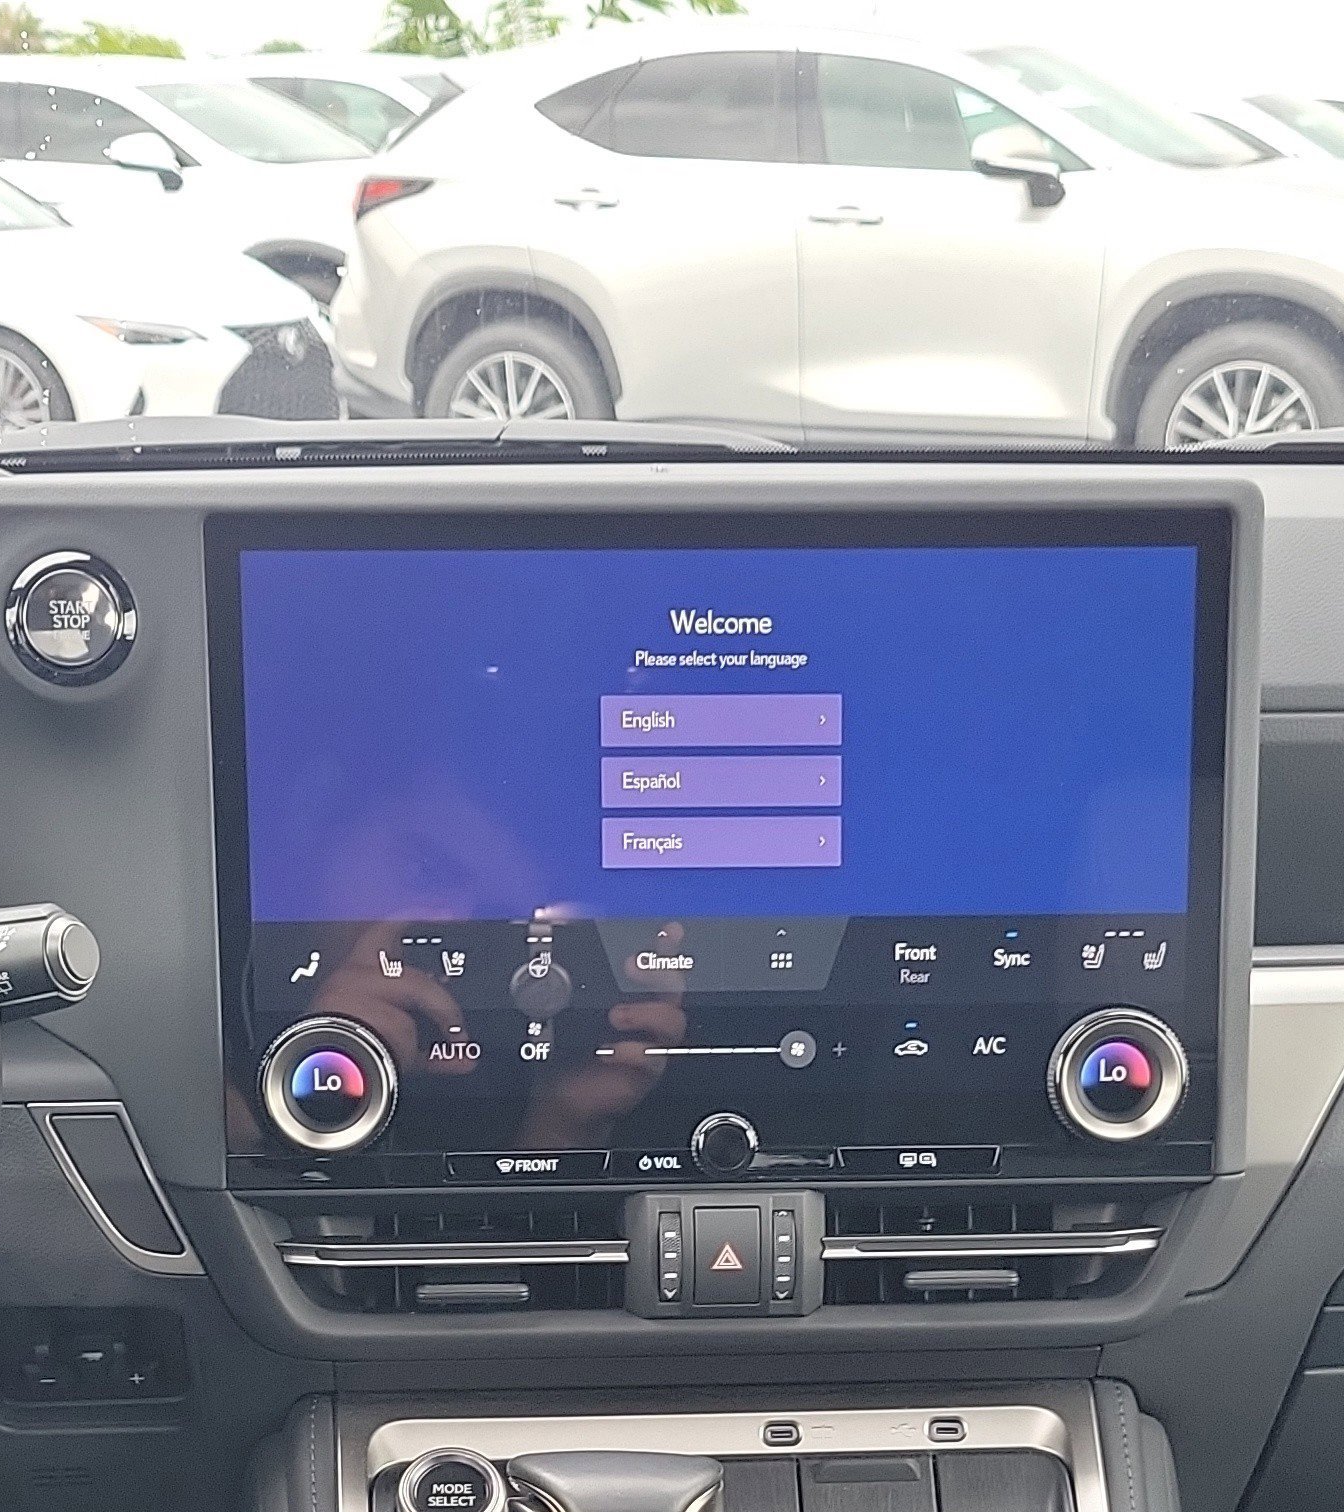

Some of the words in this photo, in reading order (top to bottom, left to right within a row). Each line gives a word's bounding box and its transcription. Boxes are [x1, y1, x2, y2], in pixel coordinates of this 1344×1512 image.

[48, 600, 93, 615] START
[52, 614, 91, 629] STOP
[669, 609, 773, 635] Welcome
[635, 650, 677, 667] Please
[679, 650, 717, 667] select
[719, 654, 748, 669] your
[750, 650, 808, 669] language
[621, 710, 676, 732] English
[621, 771, 681, 793] Español
[622, 832, 683, 855] Français
[635, 952, 694, 971] Climate
[893, 943, 938, 963] Front
[993, 948, 1031, 969] Sync
[900, 968, 931, 985] Rear
[429, 1042, 482, 1061] AUTO
[519, 1041, 550, 1061] Off
[972, 1036, 1007, 1056] A/C
[312, 1067, 343, 1092] Lo
[1098, 1058, 1128, 1083] Lo
[514, 1158, 559, 1174] FRONT
[653, 1155, 681, 1171] VOL
[432, 1482, 473, 1495] MODE
[427, 1494, 477, 1508] SELECT
